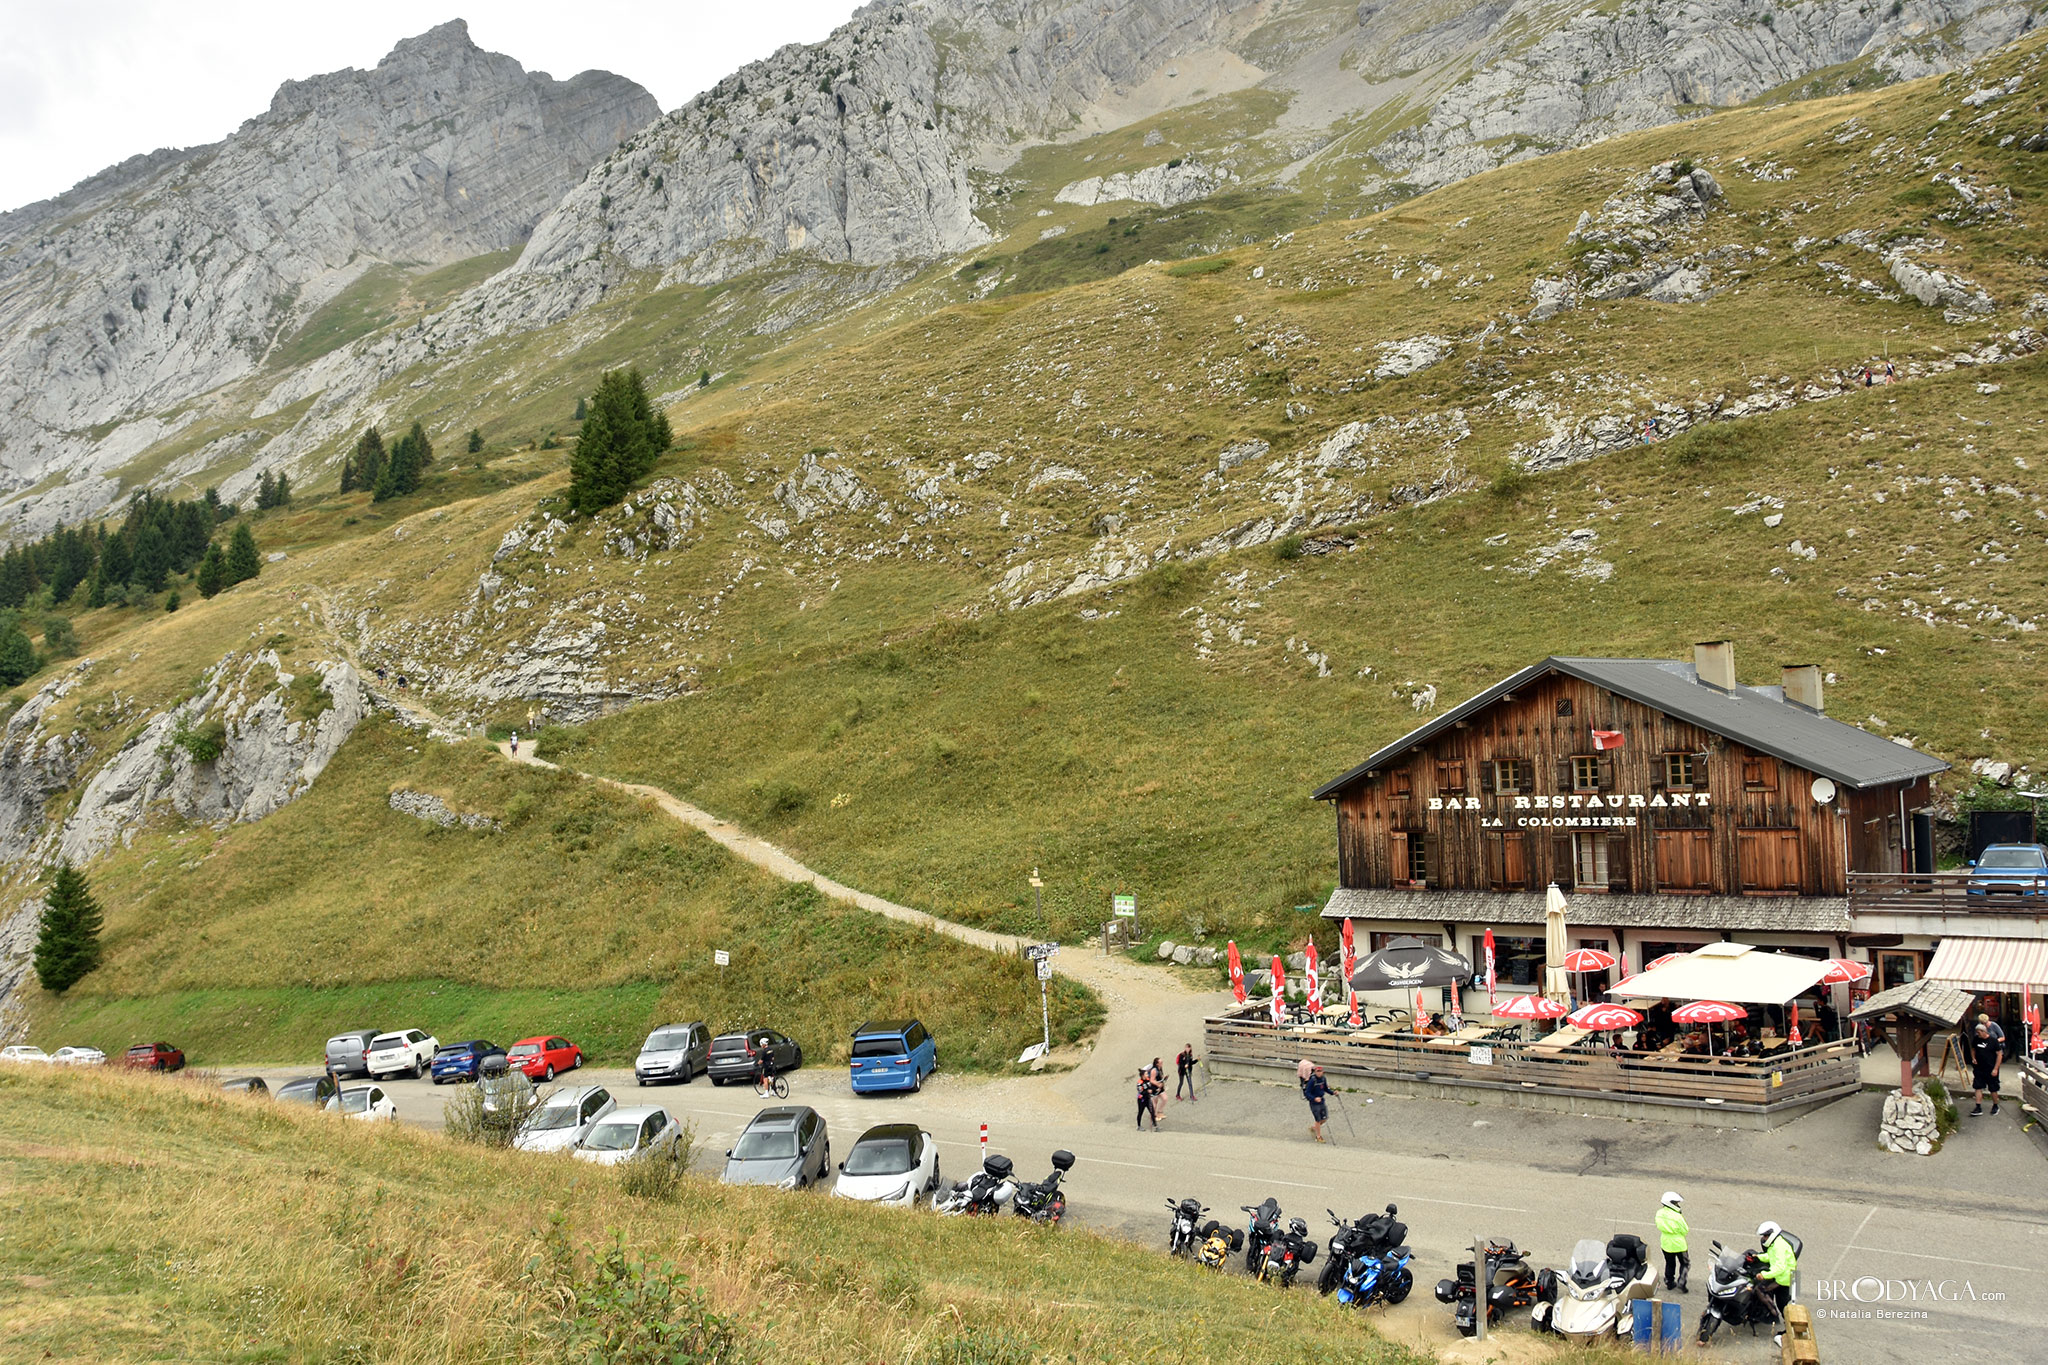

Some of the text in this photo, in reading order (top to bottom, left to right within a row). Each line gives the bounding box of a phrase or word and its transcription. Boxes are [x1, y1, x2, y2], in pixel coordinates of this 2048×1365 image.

[1428, 793, 1711, 810] BAR RESTAURANT
[1481, 816, 1637, 827] LA COLOMBIERE
